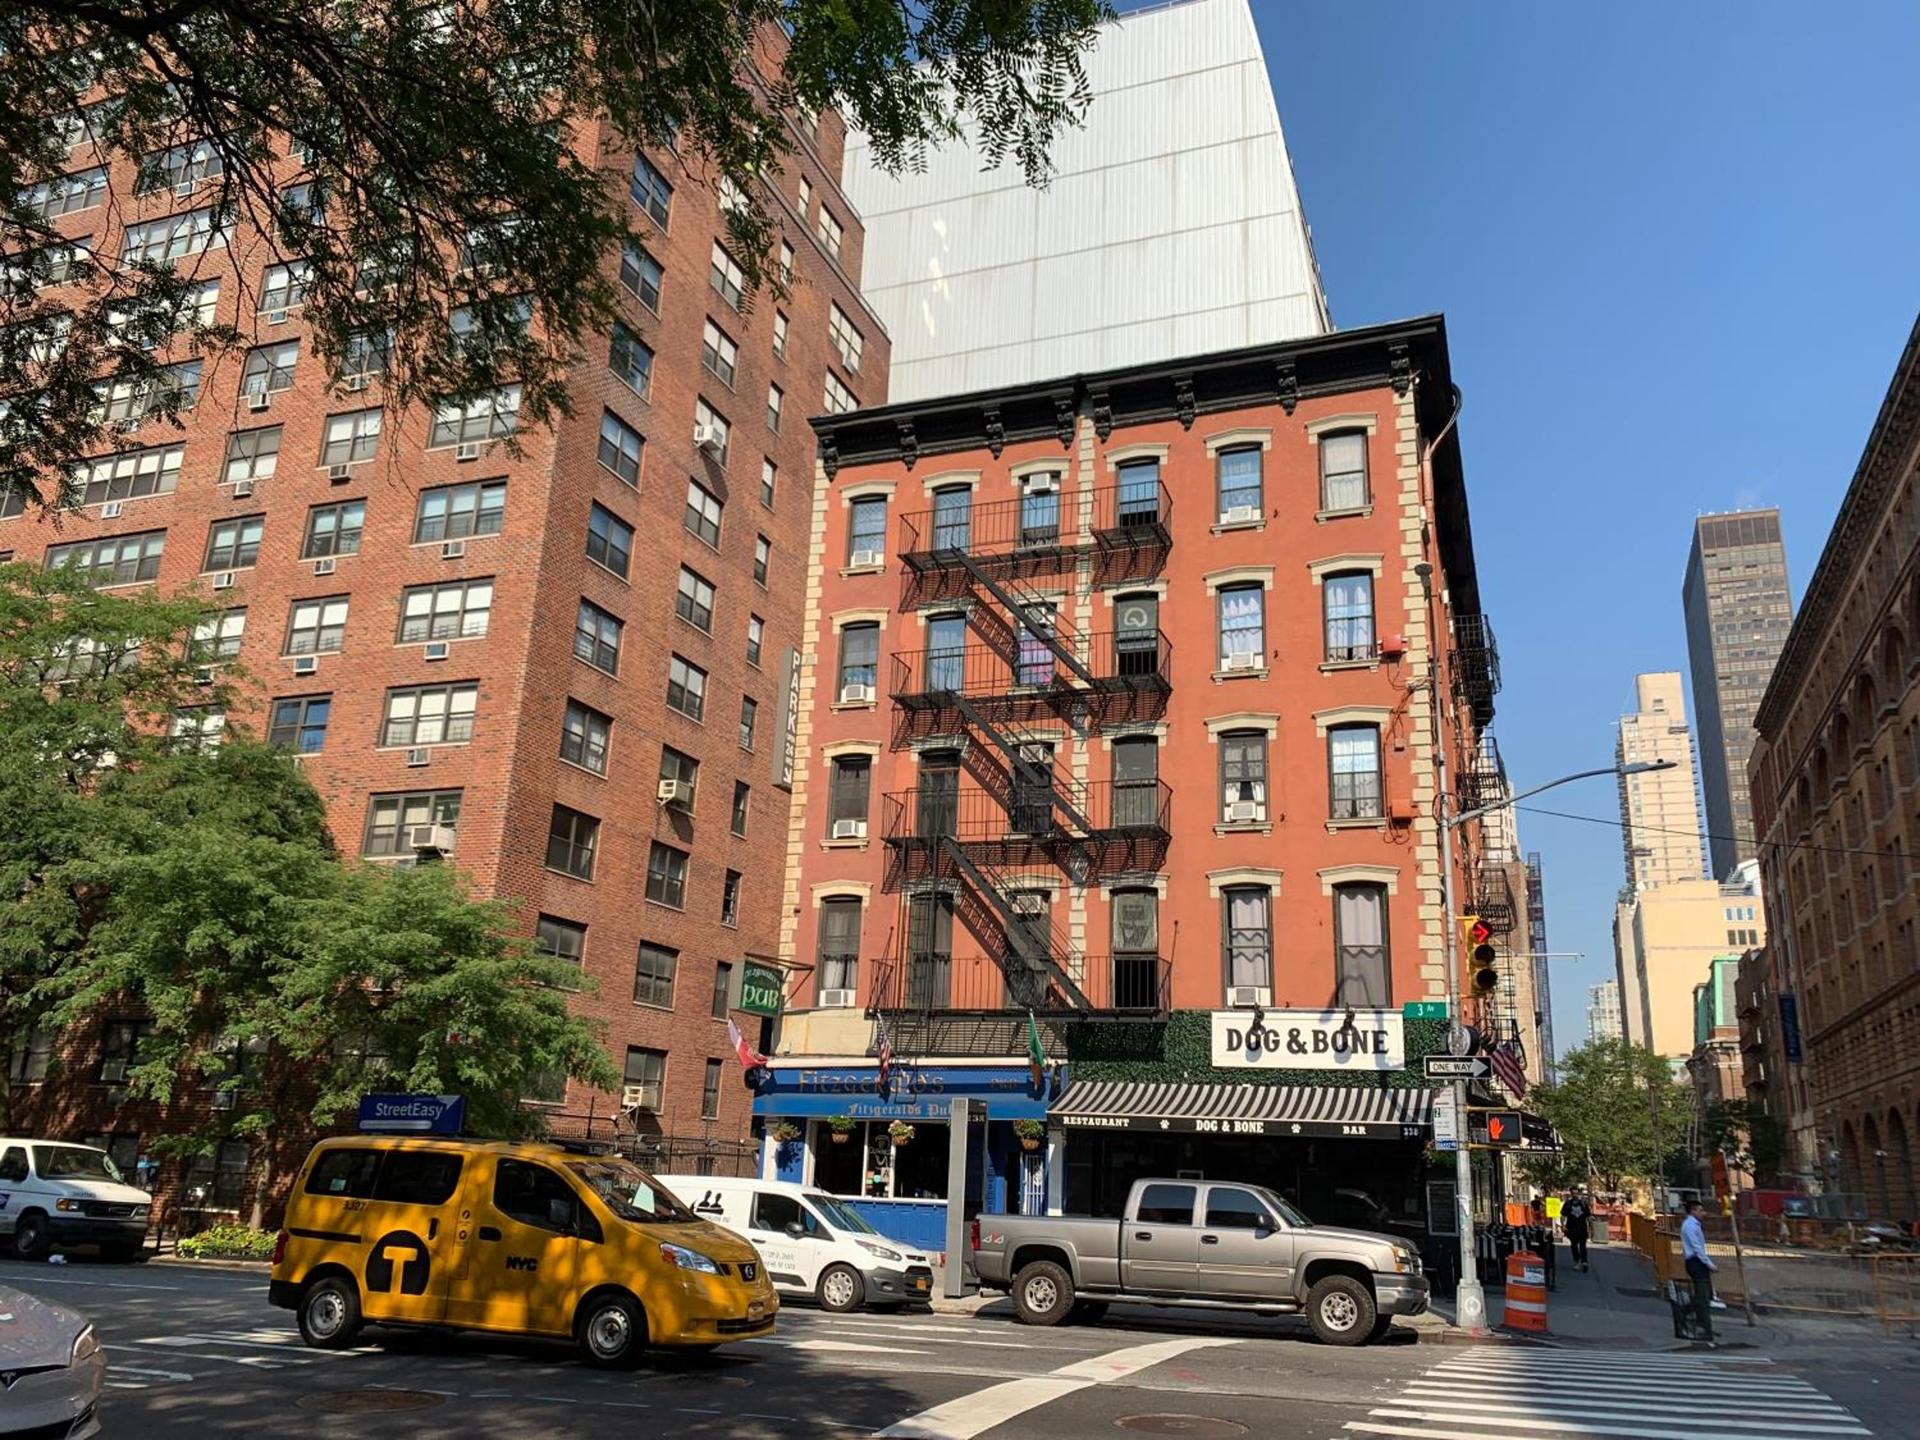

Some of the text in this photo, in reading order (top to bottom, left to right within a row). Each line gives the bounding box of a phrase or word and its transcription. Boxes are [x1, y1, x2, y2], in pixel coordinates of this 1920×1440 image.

[787, 650, 801, 735] PARK
[1417, 1003, 1424, 1016] 3
[1226, 1028, 1390, 1054] DOG & BONE
[1432, 1063, 1472, 1072] ONE WAY
[375, 1102, 444, 1120] StreetEasy
[1063, 1116, 1130, 1127] RESTAURANT
[1195, 1119, 1265, 1134] DOG & BONE
[1342, 1125, 1367, 1135] BAR
[382, 1246, 418, 1296] T
[505, 1256, 538, 1271] NYC
